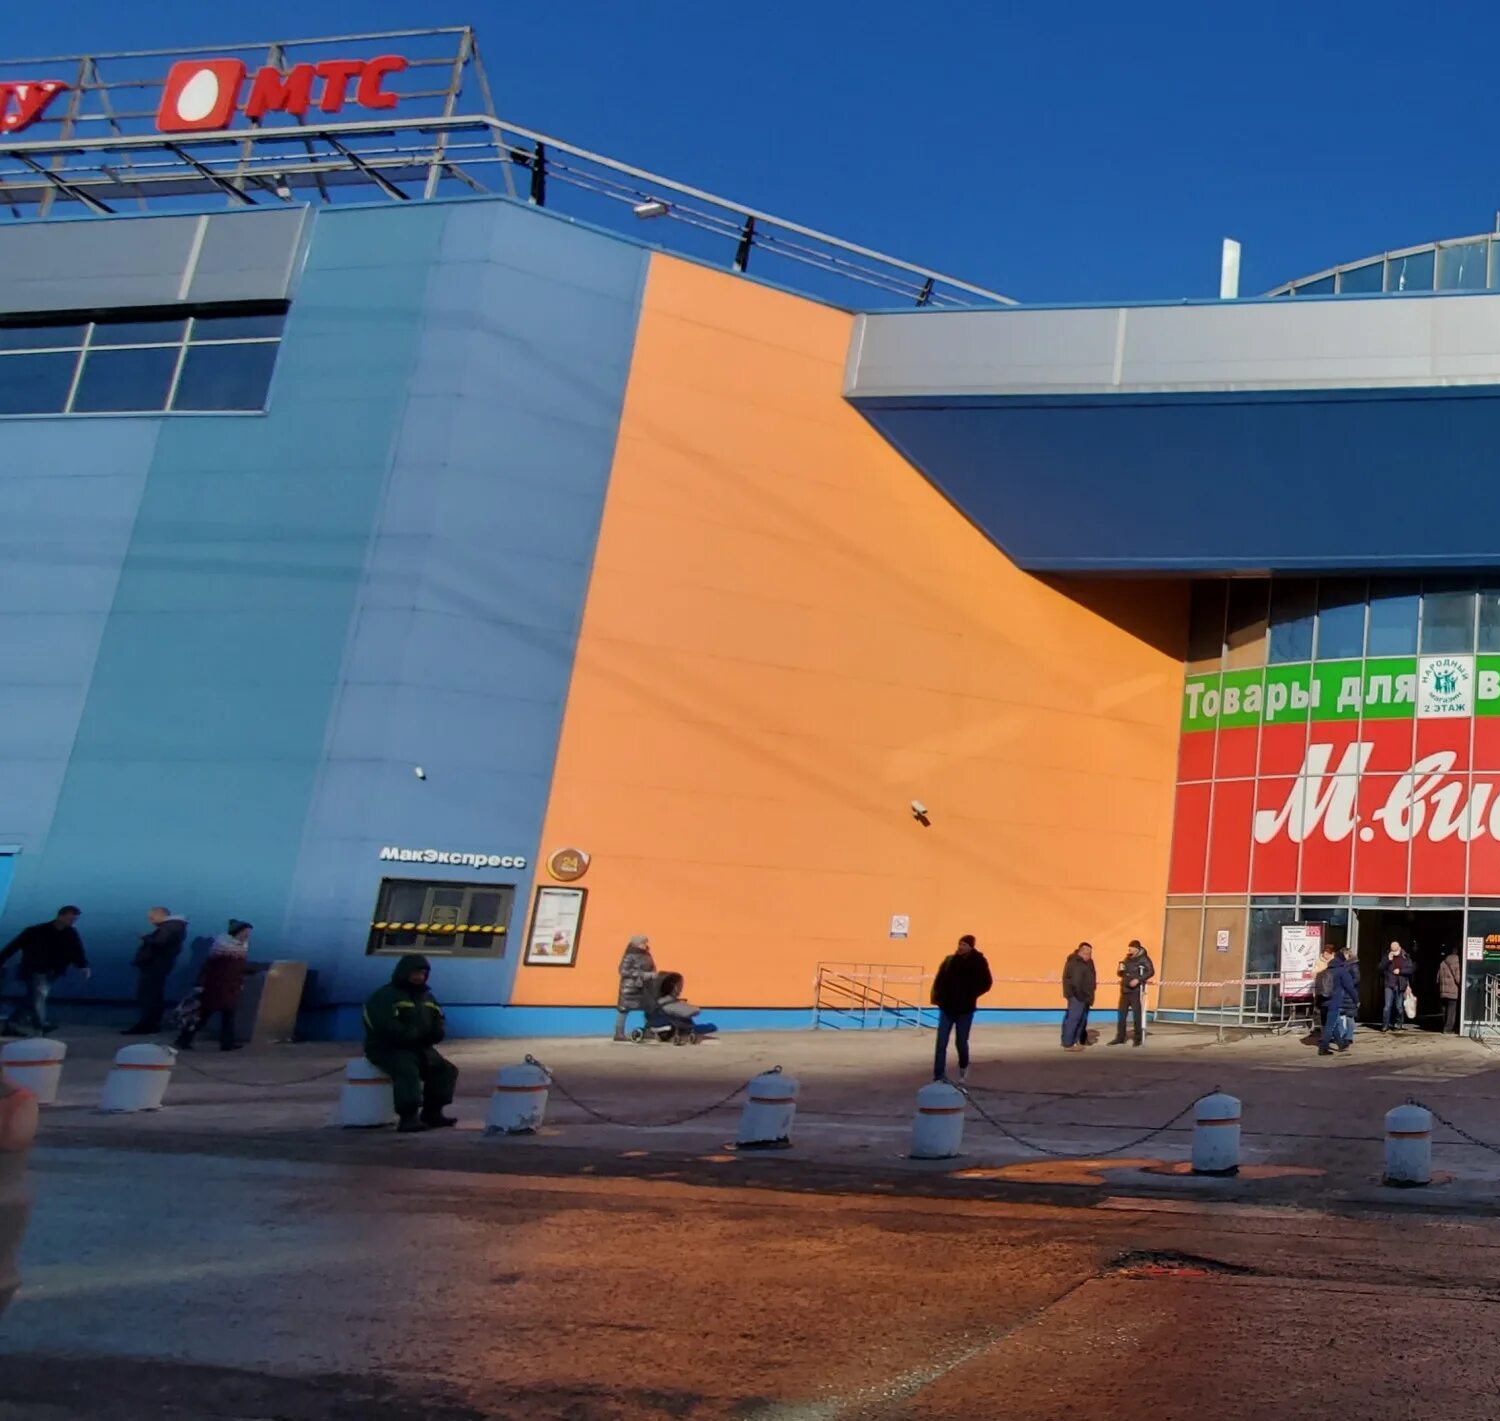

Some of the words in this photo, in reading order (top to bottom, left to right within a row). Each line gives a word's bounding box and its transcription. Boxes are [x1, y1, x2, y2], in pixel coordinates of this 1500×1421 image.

[245, 55, 408, 119] МТС
[1422, 659, 1469, 684] НАРОДНЫЙ
[1185, 679, 1321, 721] Товары
[1337, 674, 1417, 713] для
[1434, 704, 1466, 712] ЭТАЖ
[380, 847, 527, 868] МакЭкспресс
